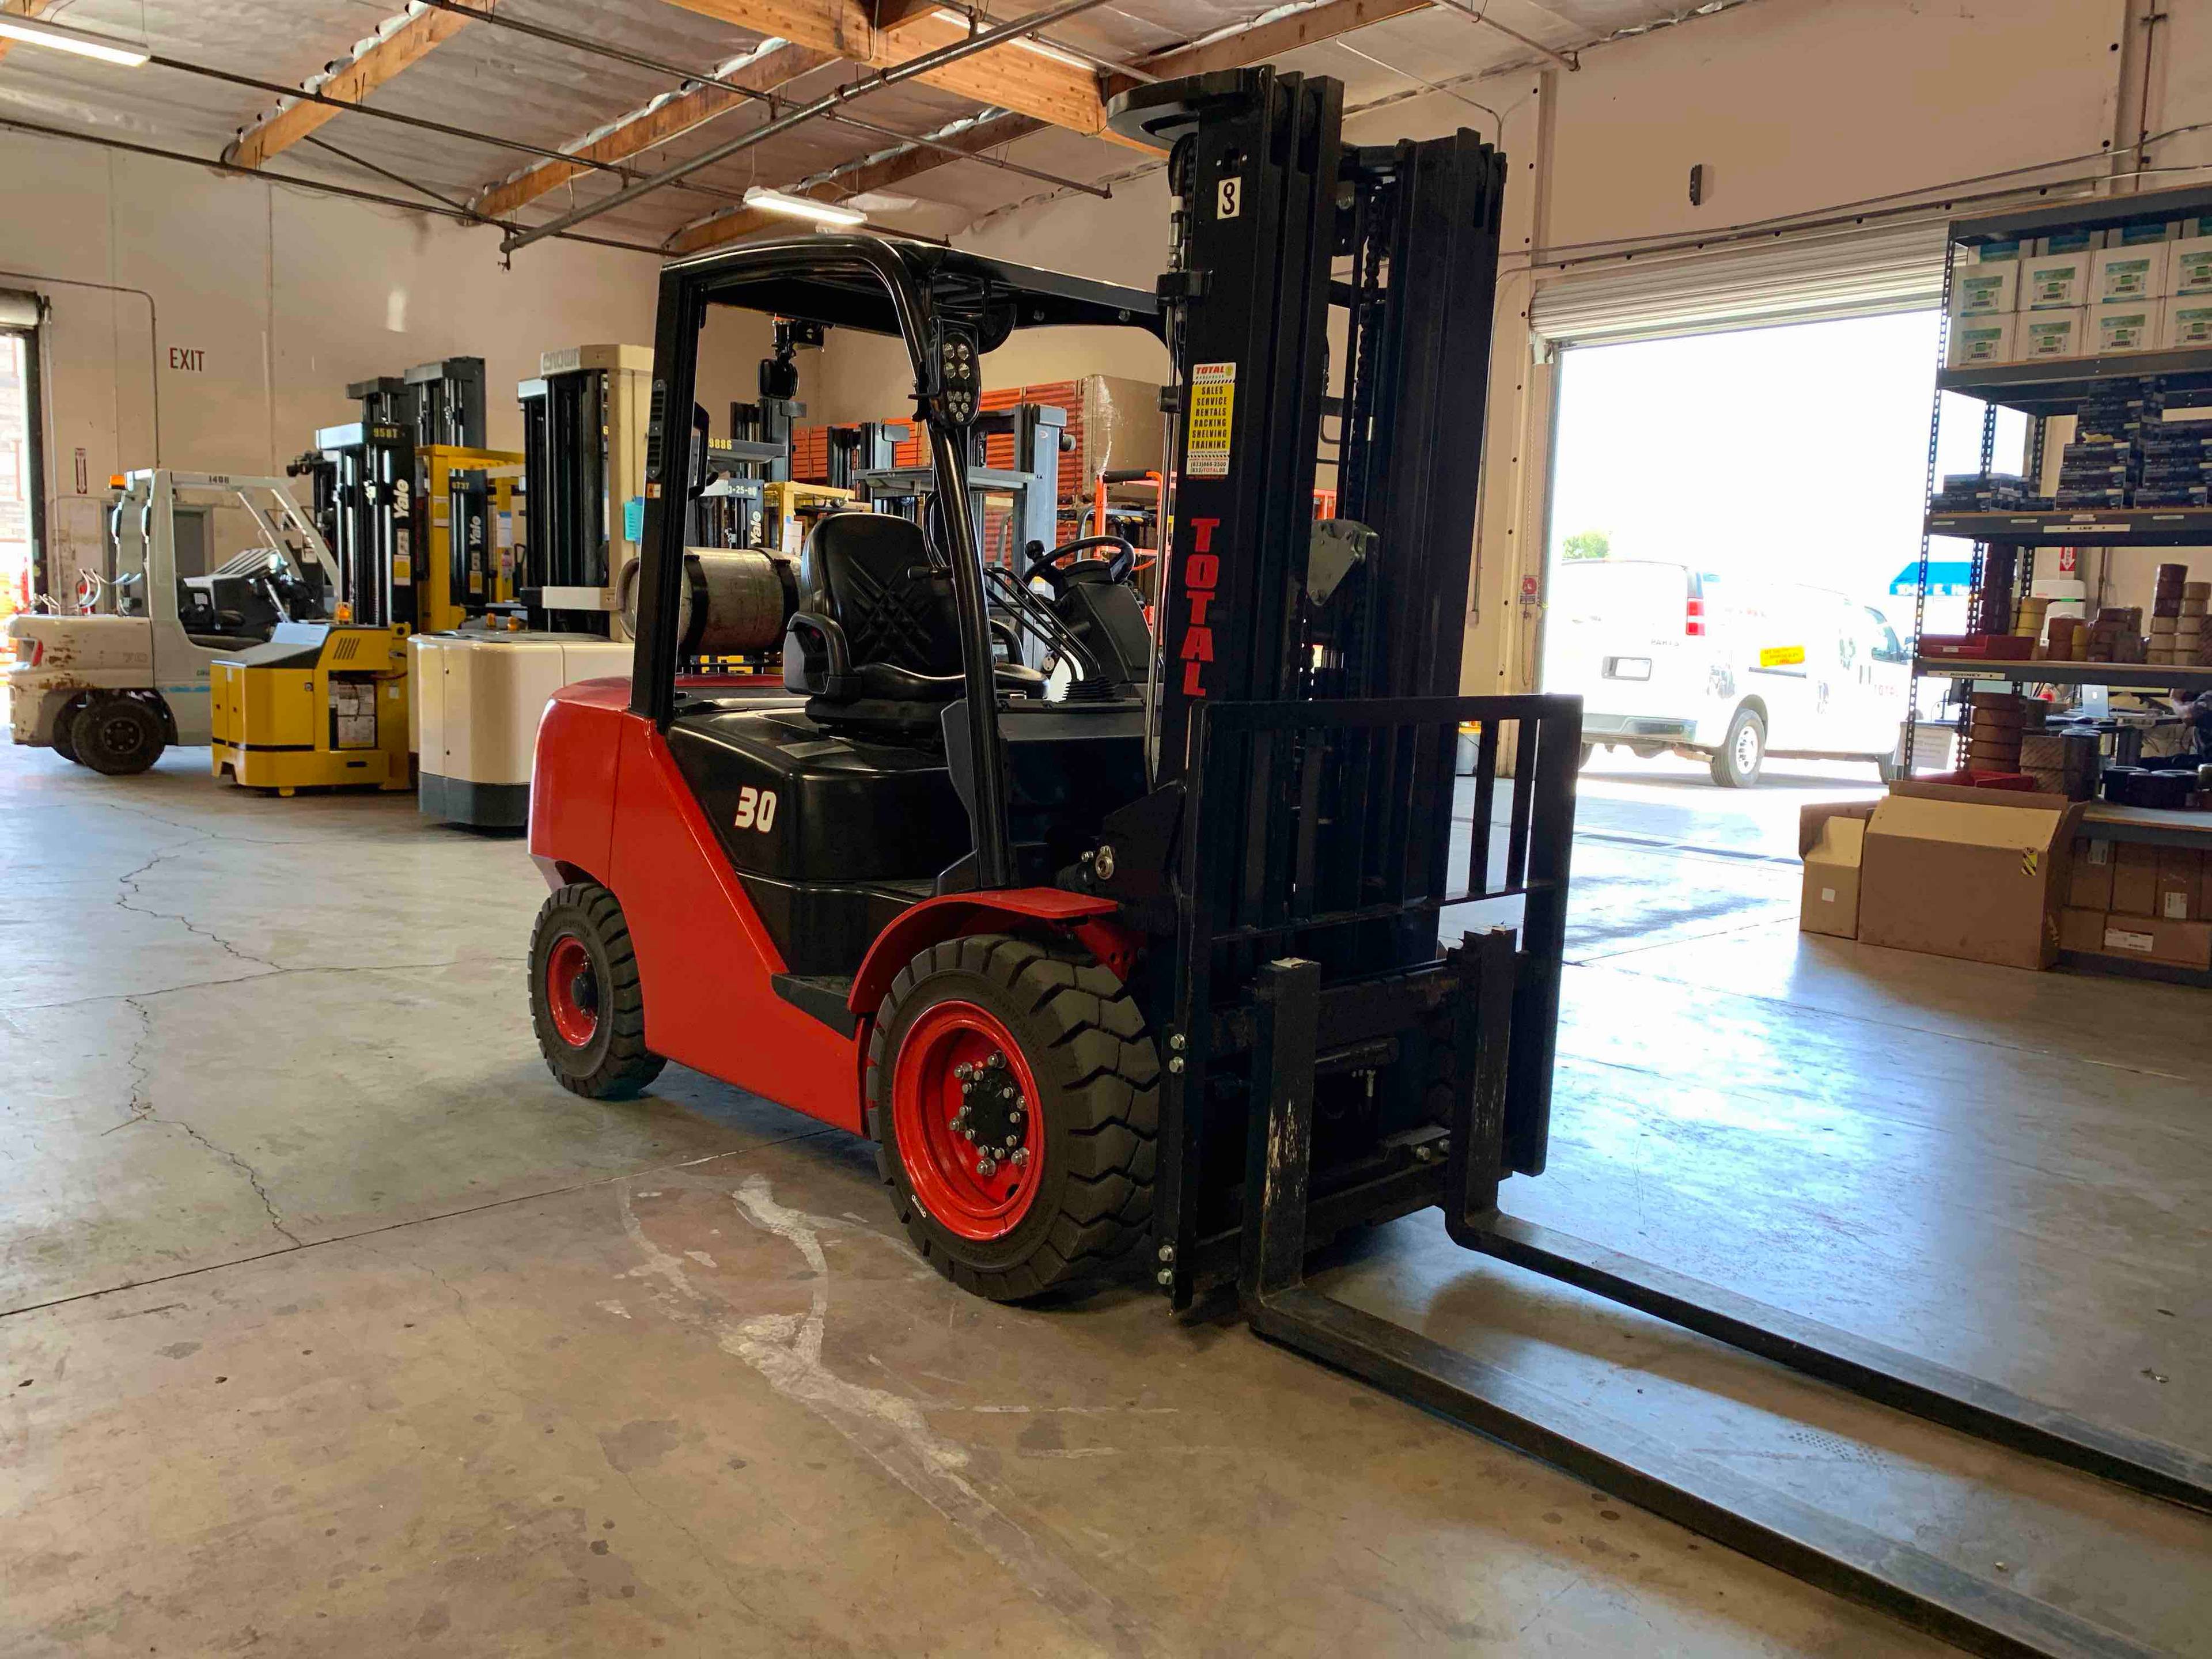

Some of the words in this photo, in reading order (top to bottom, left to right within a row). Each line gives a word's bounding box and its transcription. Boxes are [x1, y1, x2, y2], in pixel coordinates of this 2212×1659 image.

[170, 347, 205, 372] EXIT
[1196, 366, 1224, 374] TOTAL
[1202, 386, 1224, 395] SALES
[1196, 397, 1228, 406] SERVICE
[1195, 407, 1226, 416] RENTALS
[1194, 418, 1226, 427] RACKING
[1192, 429, 1227, 438] SHELVING
[1191, 440, 1226, 449] TRAINING
[393, 479, 410, 518] Yale
[469, 516, 482, 546] Yale
[750, 510, 762, 545] Yale
[1180, 517, 1221, 697] TOTAL
[734, 786, 778, 833] 30
